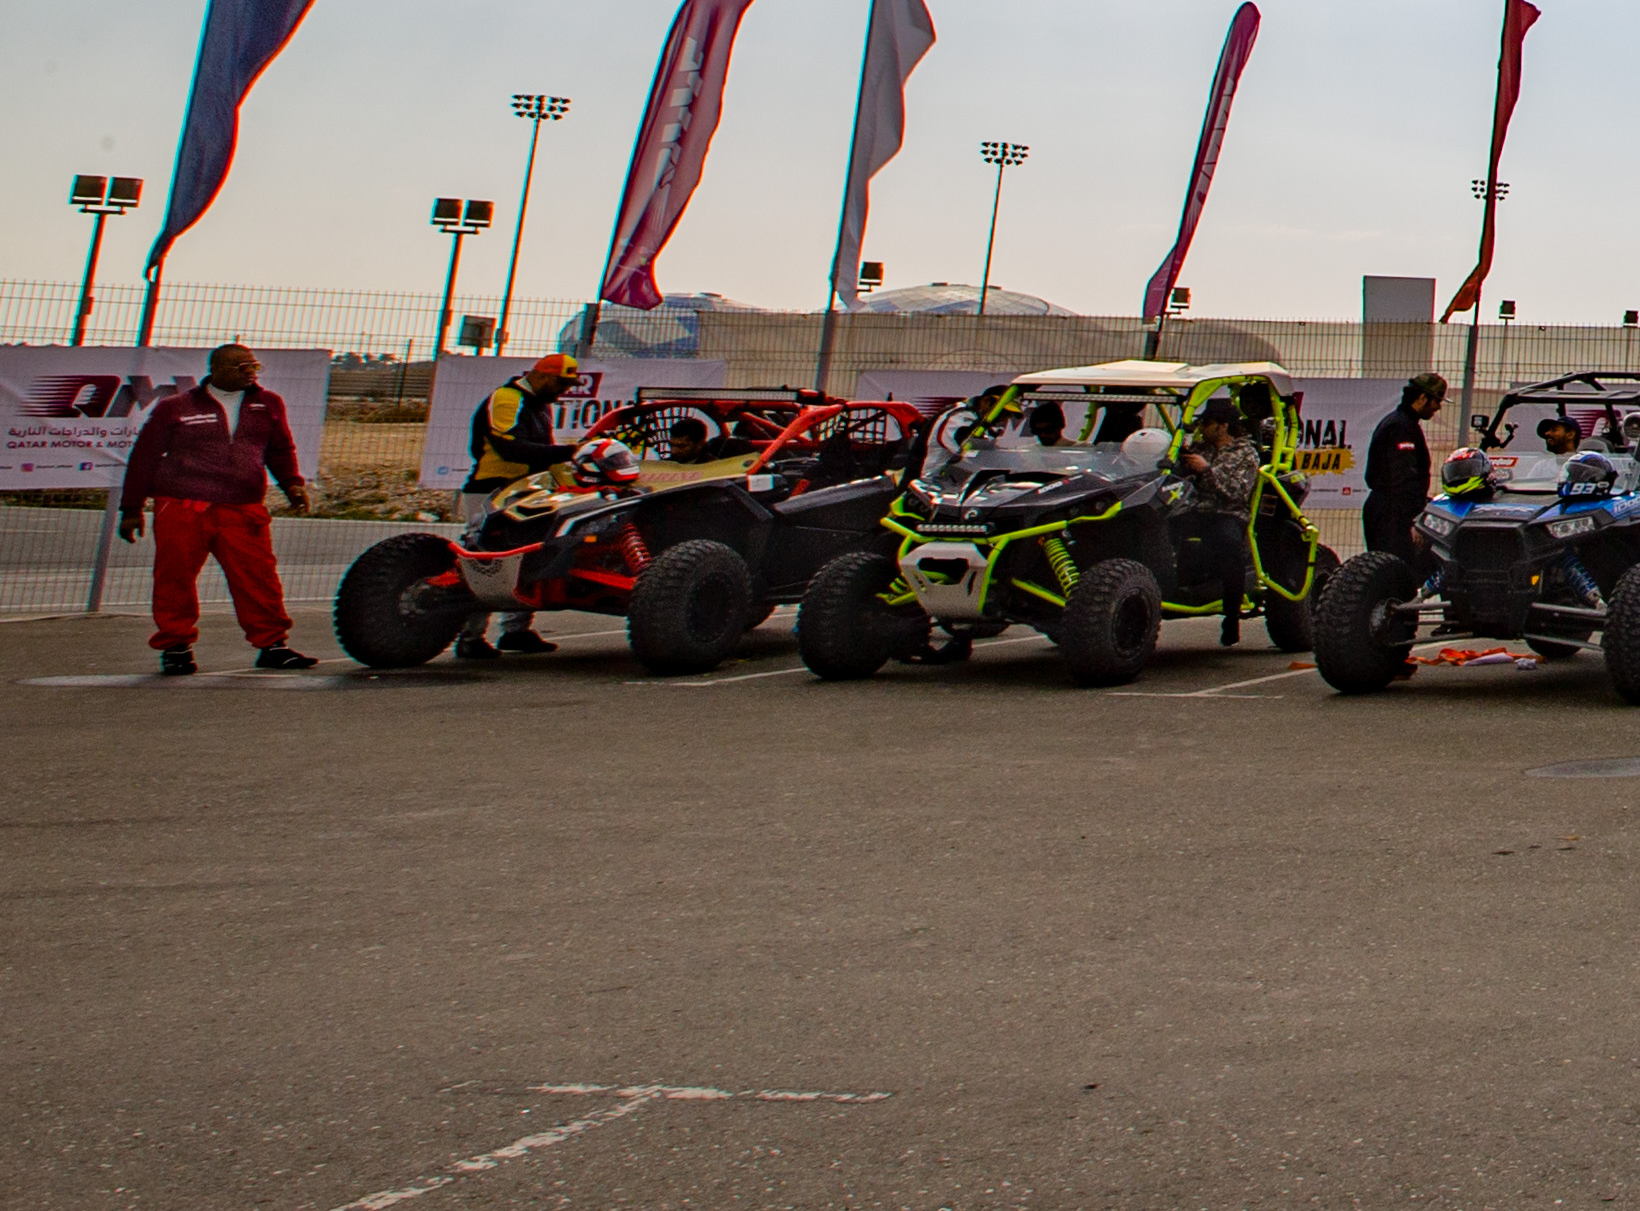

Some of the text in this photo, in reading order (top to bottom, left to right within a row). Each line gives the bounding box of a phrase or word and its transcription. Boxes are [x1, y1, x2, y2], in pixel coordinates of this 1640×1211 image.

[6, 440, 47, 449] QATAR
[50, 440, 92, 448] MOTOR
[1301, 454, 1341, 470] BAJA
